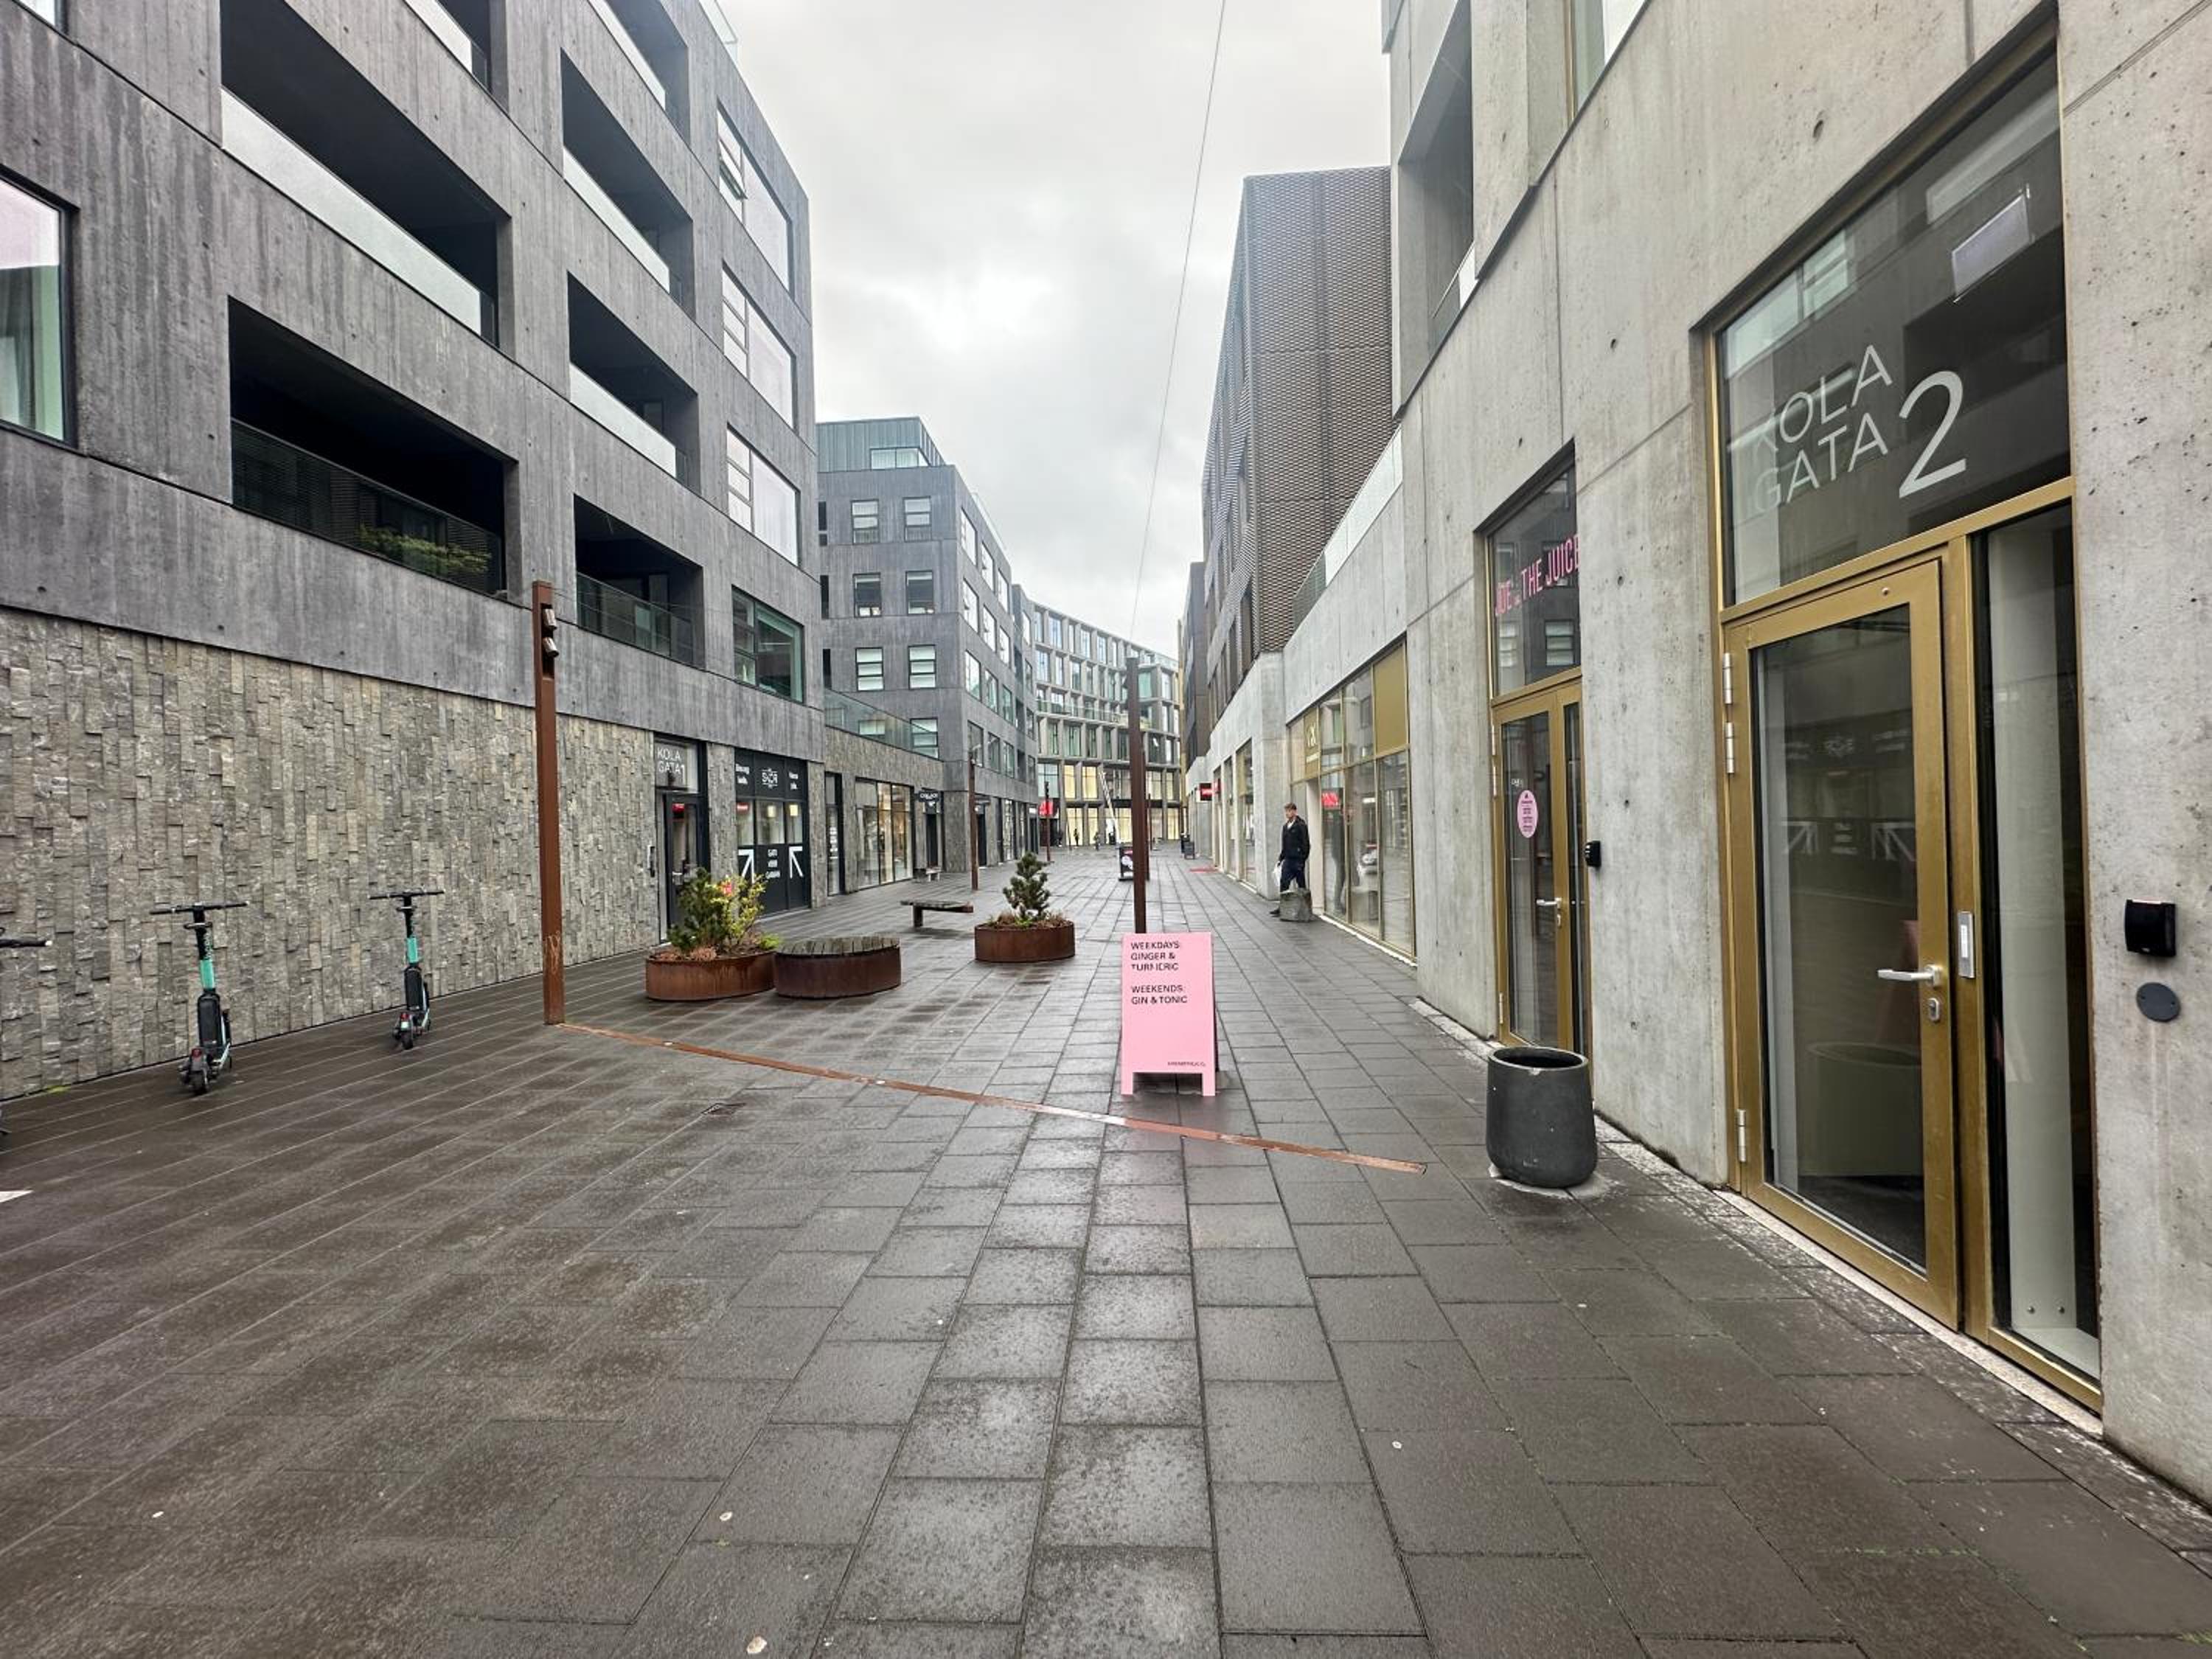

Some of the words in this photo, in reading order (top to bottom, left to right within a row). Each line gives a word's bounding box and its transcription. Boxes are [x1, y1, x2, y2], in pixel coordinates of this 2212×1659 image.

[1754, 412, 1888, 512] GATA
[1899, 370, 1966, 499] 2
[1521, 558, 1543, 601] THE
[658, 760, 681, 775] GATA
[681, 765, 685, 784] 1
[1130, 952, 1166, 961] GINGER
[1131, 962, 1179, 971] TURMERIC
[1131, 996, 1148, 1005] GIN
[1150, 996, 1158, 1004] &
[1159, 995, 1188, 1004] TONIC
